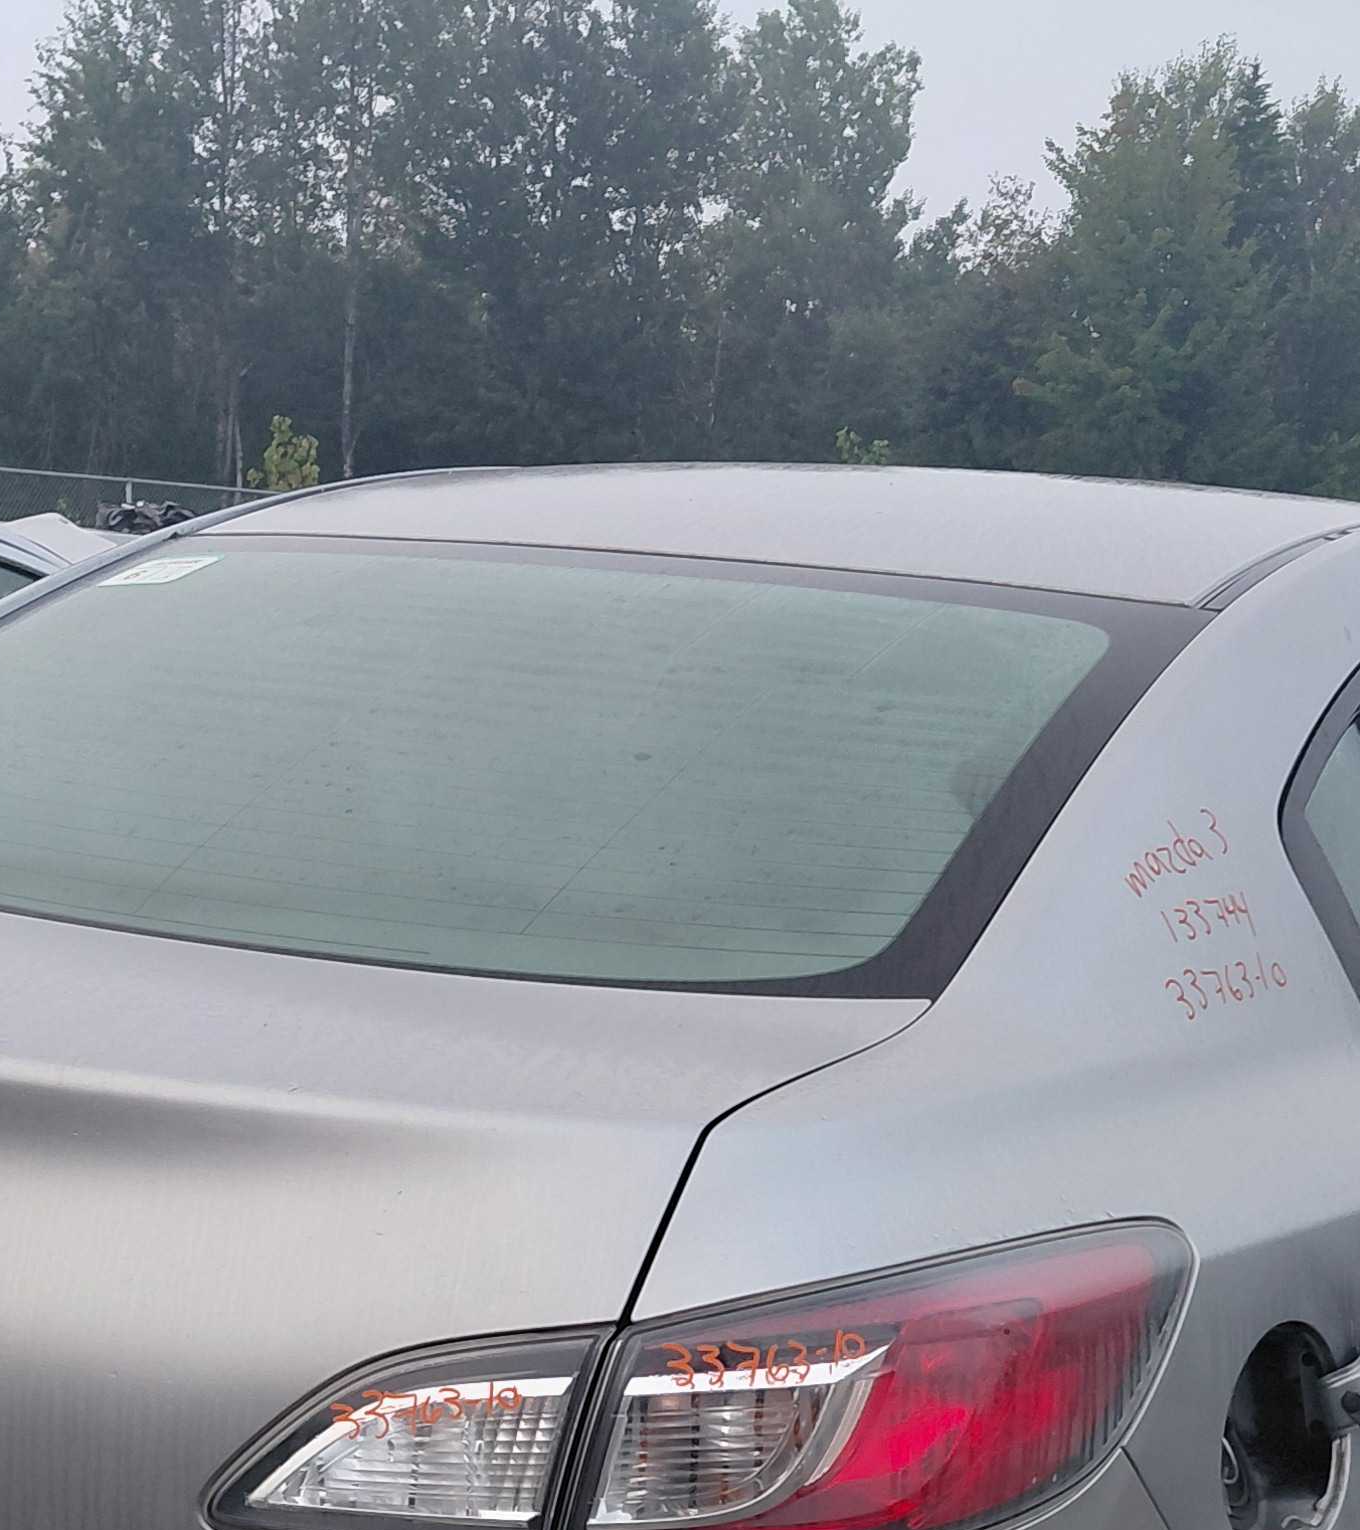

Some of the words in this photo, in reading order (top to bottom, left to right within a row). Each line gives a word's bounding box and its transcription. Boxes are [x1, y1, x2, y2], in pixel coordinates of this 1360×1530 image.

[1165, 951, 1288, 1021] 33763-10
[662, 1328, 867, 1389] 33763-10
[330, 1380, 523, 1440] 33763-10
